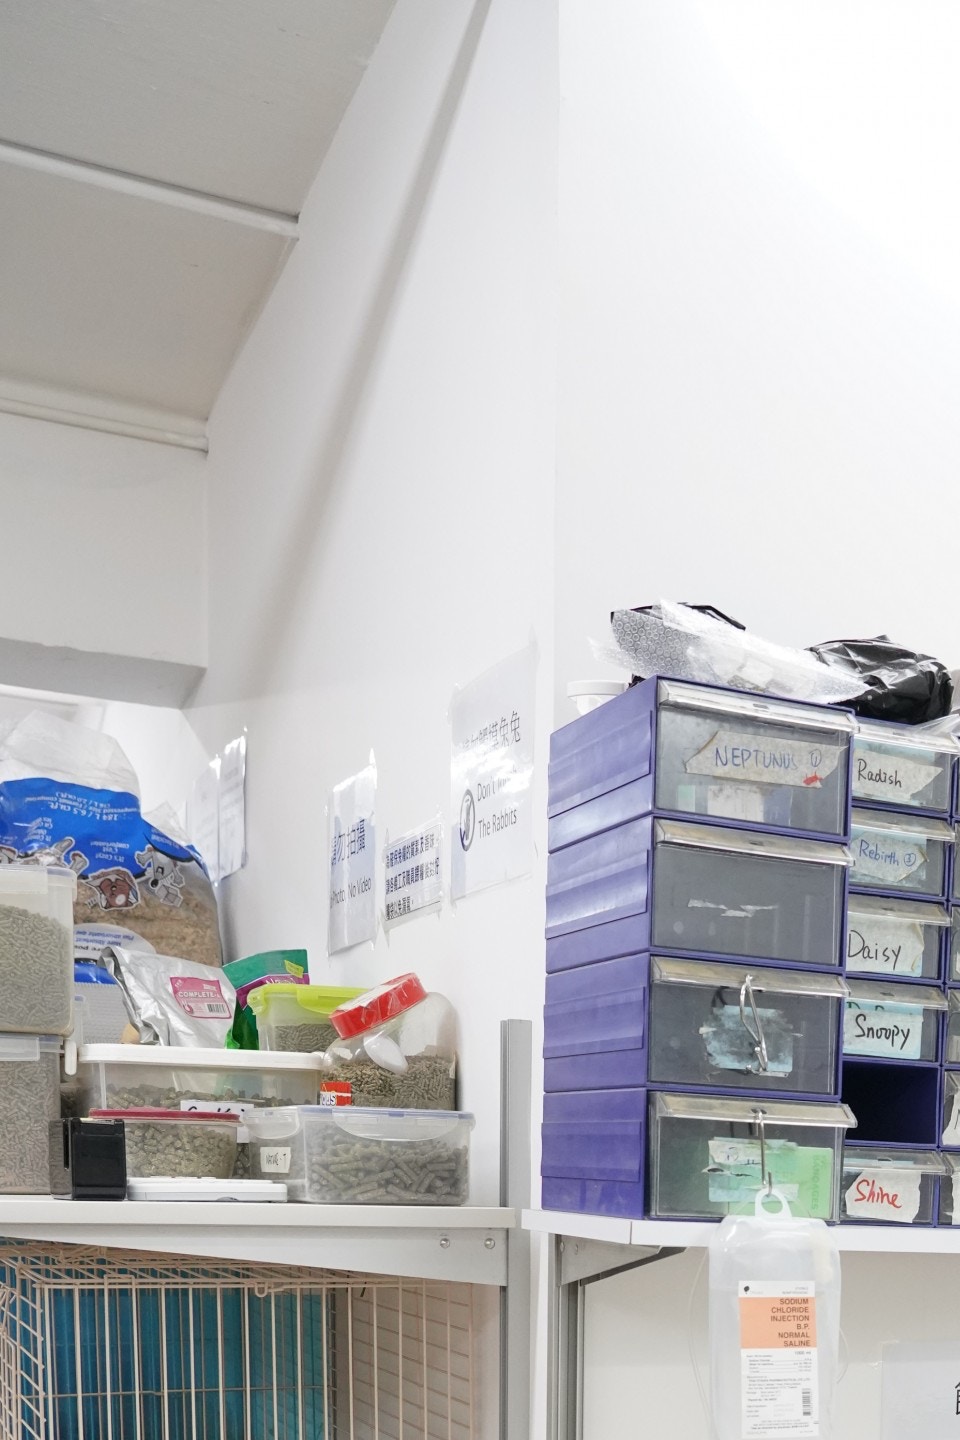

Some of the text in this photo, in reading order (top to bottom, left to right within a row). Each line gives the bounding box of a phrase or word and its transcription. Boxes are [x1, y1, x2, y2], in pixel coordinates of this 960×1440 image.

[857, 758, 902, 788] Radish
[478, 809, 517, 839] The Rabbits
[859, 839, 899, 866] Rebirth
[357, 875, 372, 894] Video
[848, 929, 901, 971] Daisy
[855, 1013, 911, 1051] Snoopy
[854, 1179, 902, 1209] Shine
